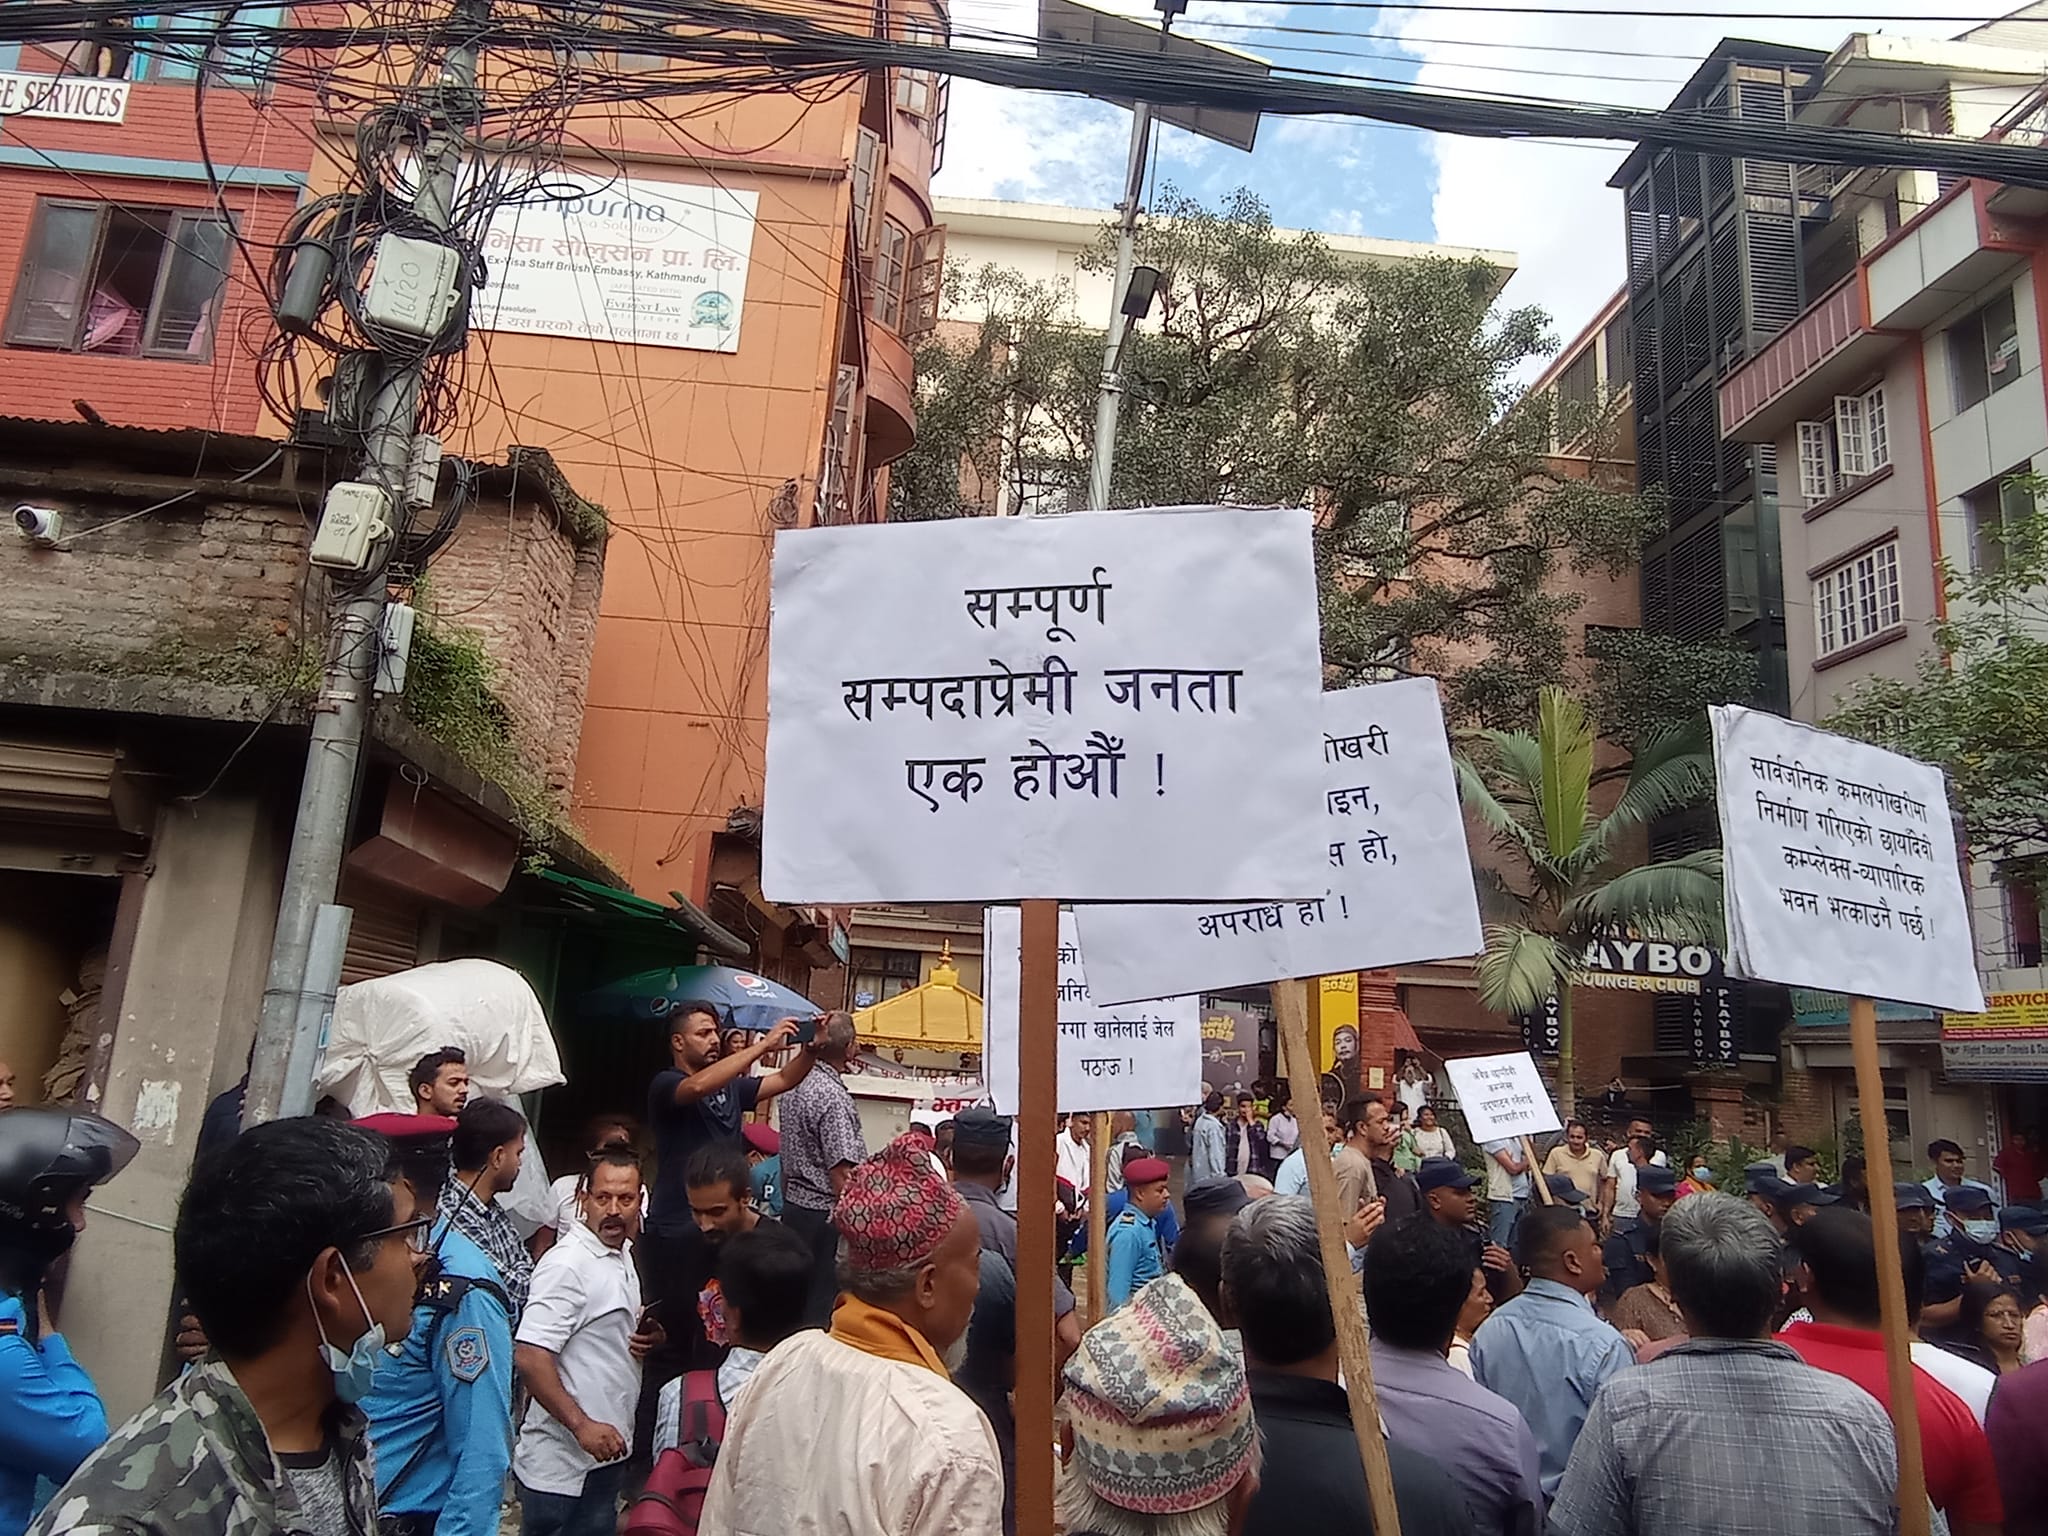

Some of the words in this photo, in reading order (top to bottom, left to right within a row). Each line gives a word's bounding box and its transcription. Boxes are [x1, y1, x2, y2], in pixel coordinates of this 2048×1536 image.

[21, 81, 122, 117] SERVICES
[528, 258, 554, 271] Staff
[556, 261, 590, 275] British
[593, 264, 644, 281] Embassy,
[646, 269, 707, 285] Kathmandu
[965, 567, 1112, 642] सम्पूर्ण
[842, 655, 1078, 721] सम्पदाप्रेमी
[1104, 669, 1243, 713] जनता
[1323, 724, 1389, 763] ोखरी
[905, 757, 986, 813] एक
[1156, 753, 1165, 797] !
[1327, 786, 1380, 816] ाइन,
[1750, 755, 1829, 796] सार्वजनिक
[1836, 778, 1928, 824] कमलपोखरीमा
[1756, 790, 1808, 832] निर्माण
[1816, 808, 1872, 847] गरिएको
[1358, 829, 1398, 866] हो,
[1197, 902, 1284, 938] अपराध
[1340, 895, 1349, 919] !
[1780, 887, 1819, 916] भवन
[1827, 896, 1892, 930] भत्काउनै
[1898, 906, 1925, 941] पर्छ
[1581, 939, 1712, 976] AYBO
[1640, 977, 1653, 990] &
[1655, 979, 1698, 994] CLUB
[1094, 1015, 1148, 1041] खानेलाई
[1152, 1016, 1175, 1038] जेल
[1545, 987, 1560, 1047] AYBOY
[1717, 988, 1732, 1059] PLAYBOY
